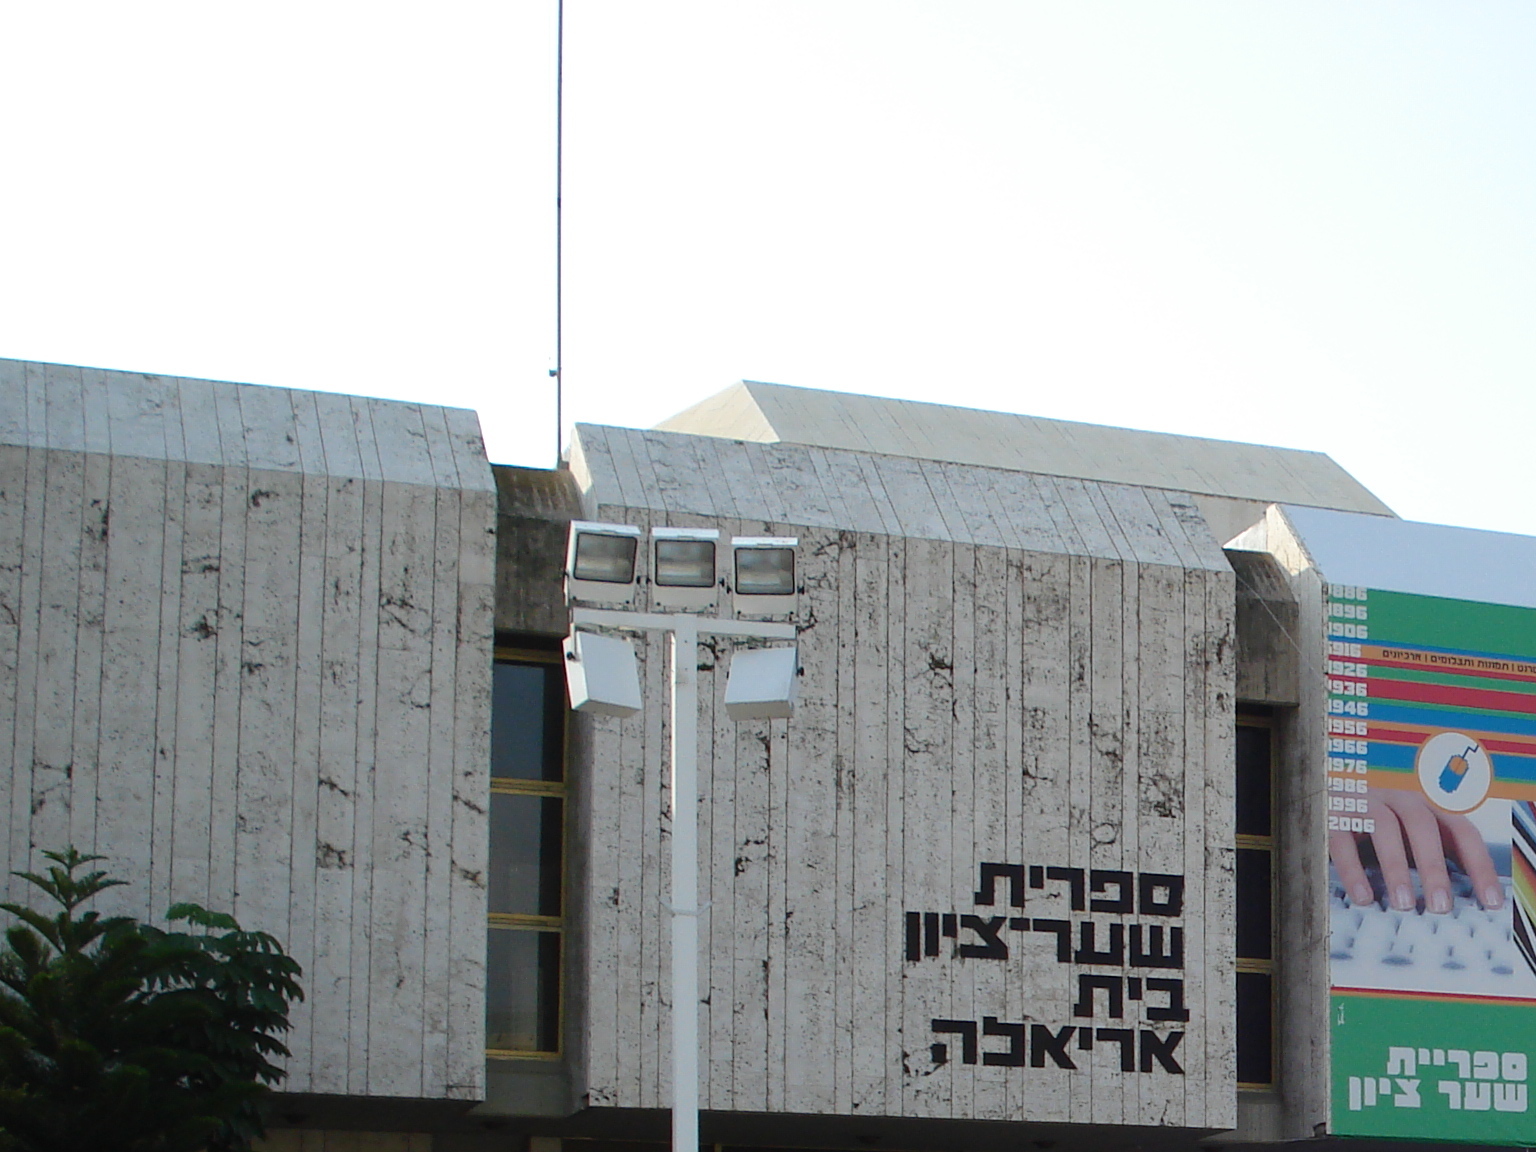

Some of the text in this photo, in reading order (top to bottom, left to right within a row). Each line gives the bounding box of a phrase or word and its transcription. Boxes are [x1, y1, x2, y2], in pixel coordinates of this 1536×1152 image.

[1328, 816, 1375, 833] 2006
[974, 862, 1184, 917] ספרית
[1073, 973, 1189, 1022] בית
[931, 1016, 1186, 1074] אריאלה
[1387, 1046, 1527, 1081] ספריית
[1349, 1075, 1527, 1112] שער ציון
